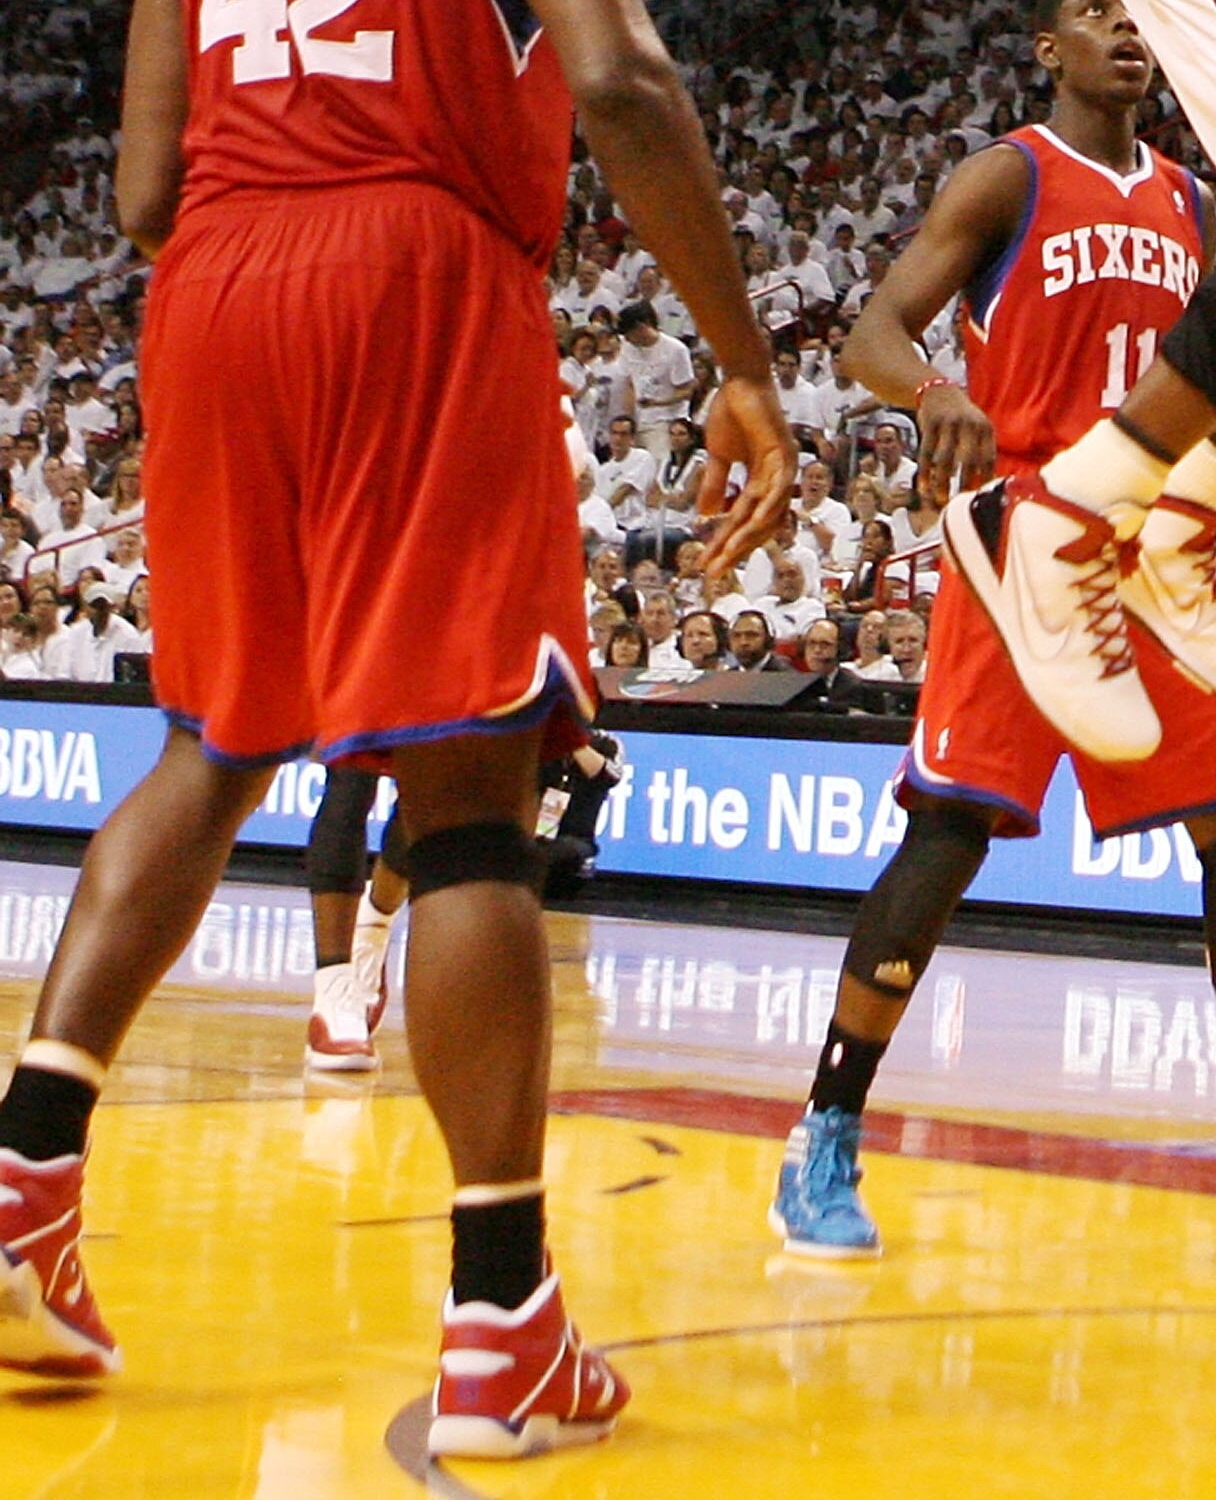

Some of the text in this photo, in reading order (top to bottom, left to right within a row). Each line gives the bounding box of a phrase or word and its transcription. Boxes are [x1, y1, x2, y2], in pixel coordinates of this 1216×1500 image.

[1100, 322, 1158, 409] 11
[647, 768, 749, 849] the
[767, 772, 909, 858] NBA
